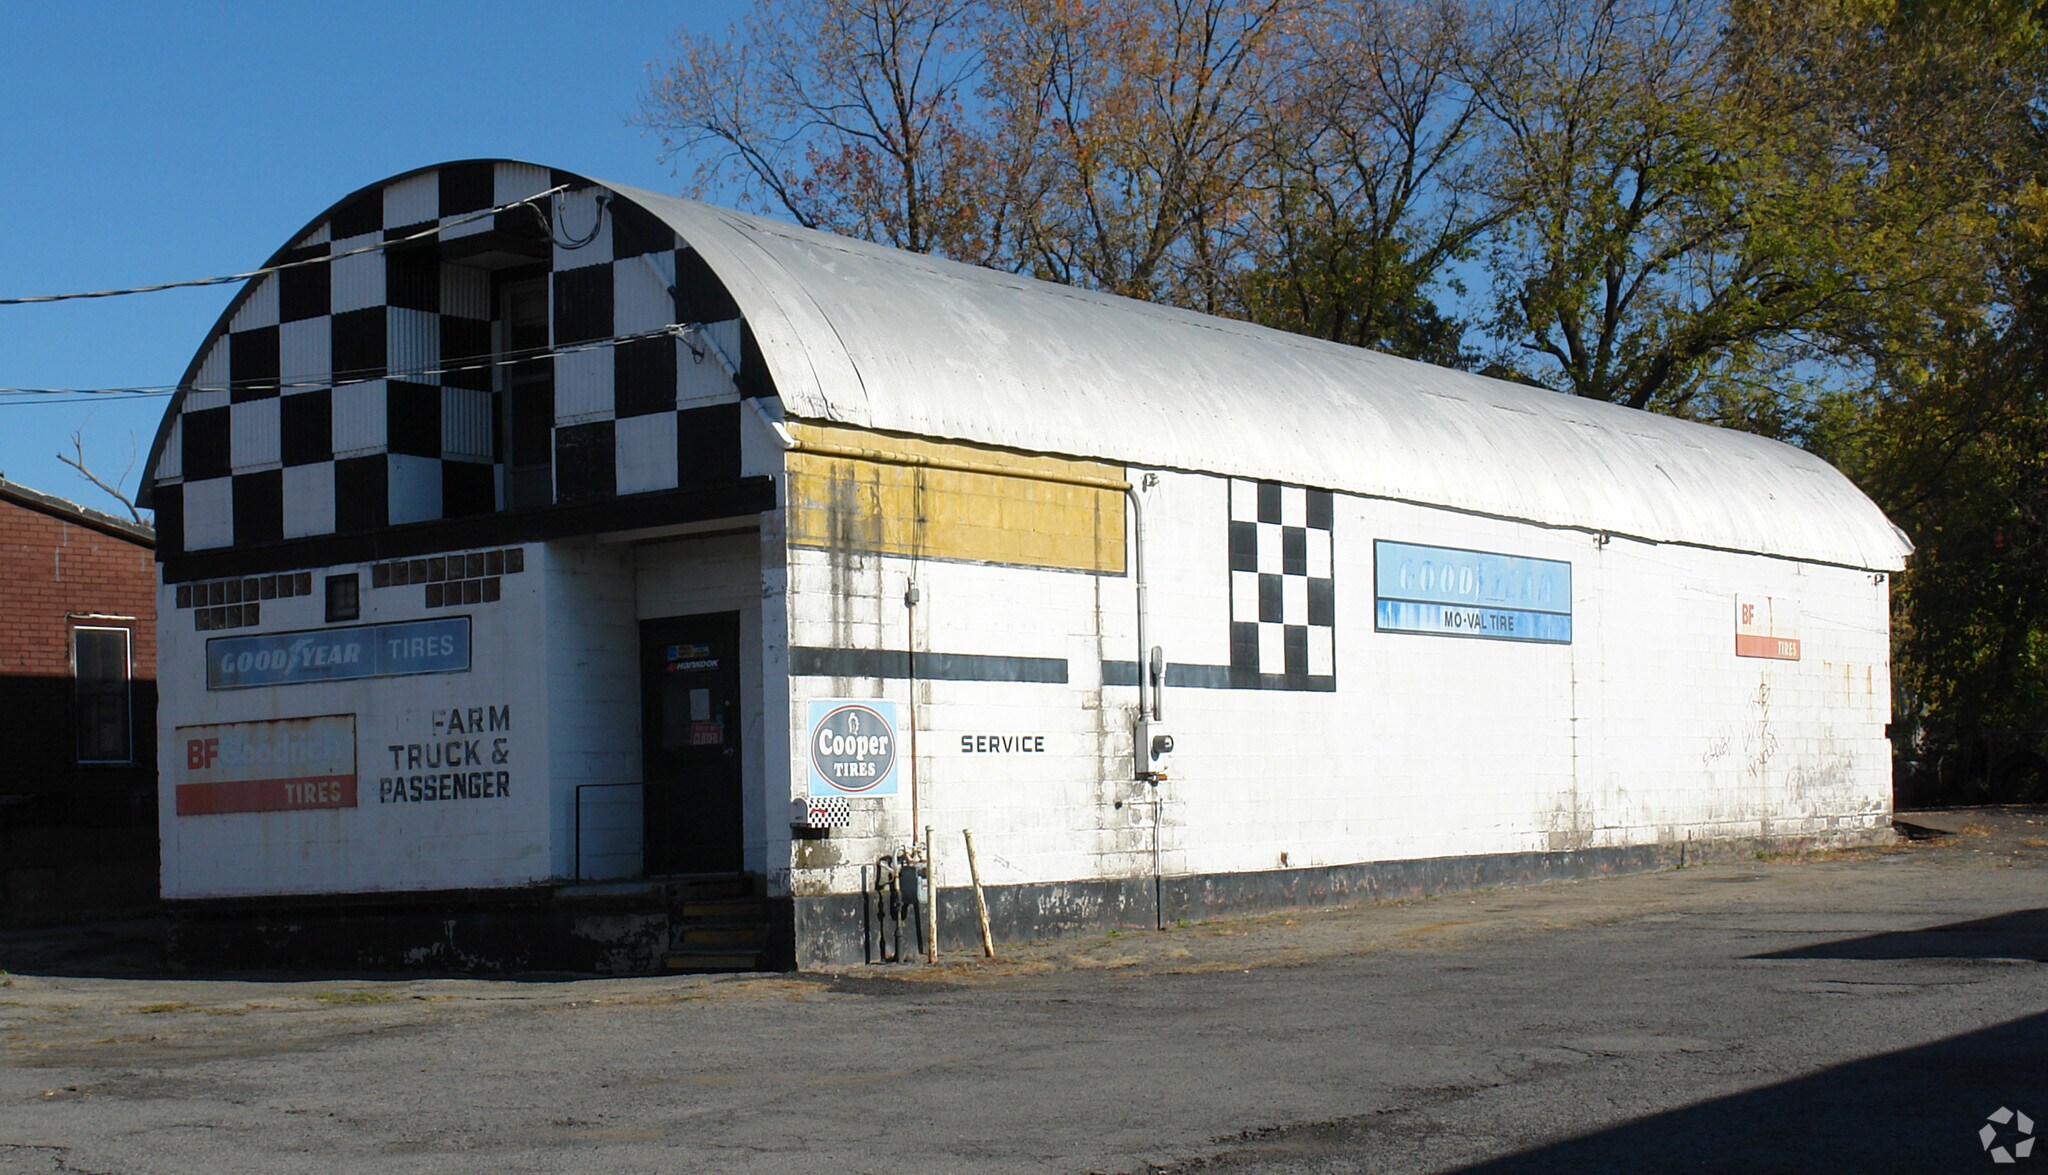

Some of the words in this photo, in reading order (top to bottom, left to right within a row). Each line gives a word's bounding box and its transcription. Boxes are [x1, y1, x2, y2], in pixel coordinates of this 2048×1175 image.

[1490, 614, 1514, 632] TIRE
[220, 638, 361, 675] GOODYEAR
[387, 634, 455, 660] TIRES
[1777, 641, 1797, 656] TIRES
[431, 704, 511, 736] FARM
[388, 739, 482, 771] TRUCK
[491, 738, 510, 765] &
[818, 728, 889, 761] Cooper
[961, 735, 1045, 753] SERVICE
[833, 762, 876, 777] TIRES
[284, 781, 342, 804] TIRES
[380, 770, 511, 804] PASSENGER
